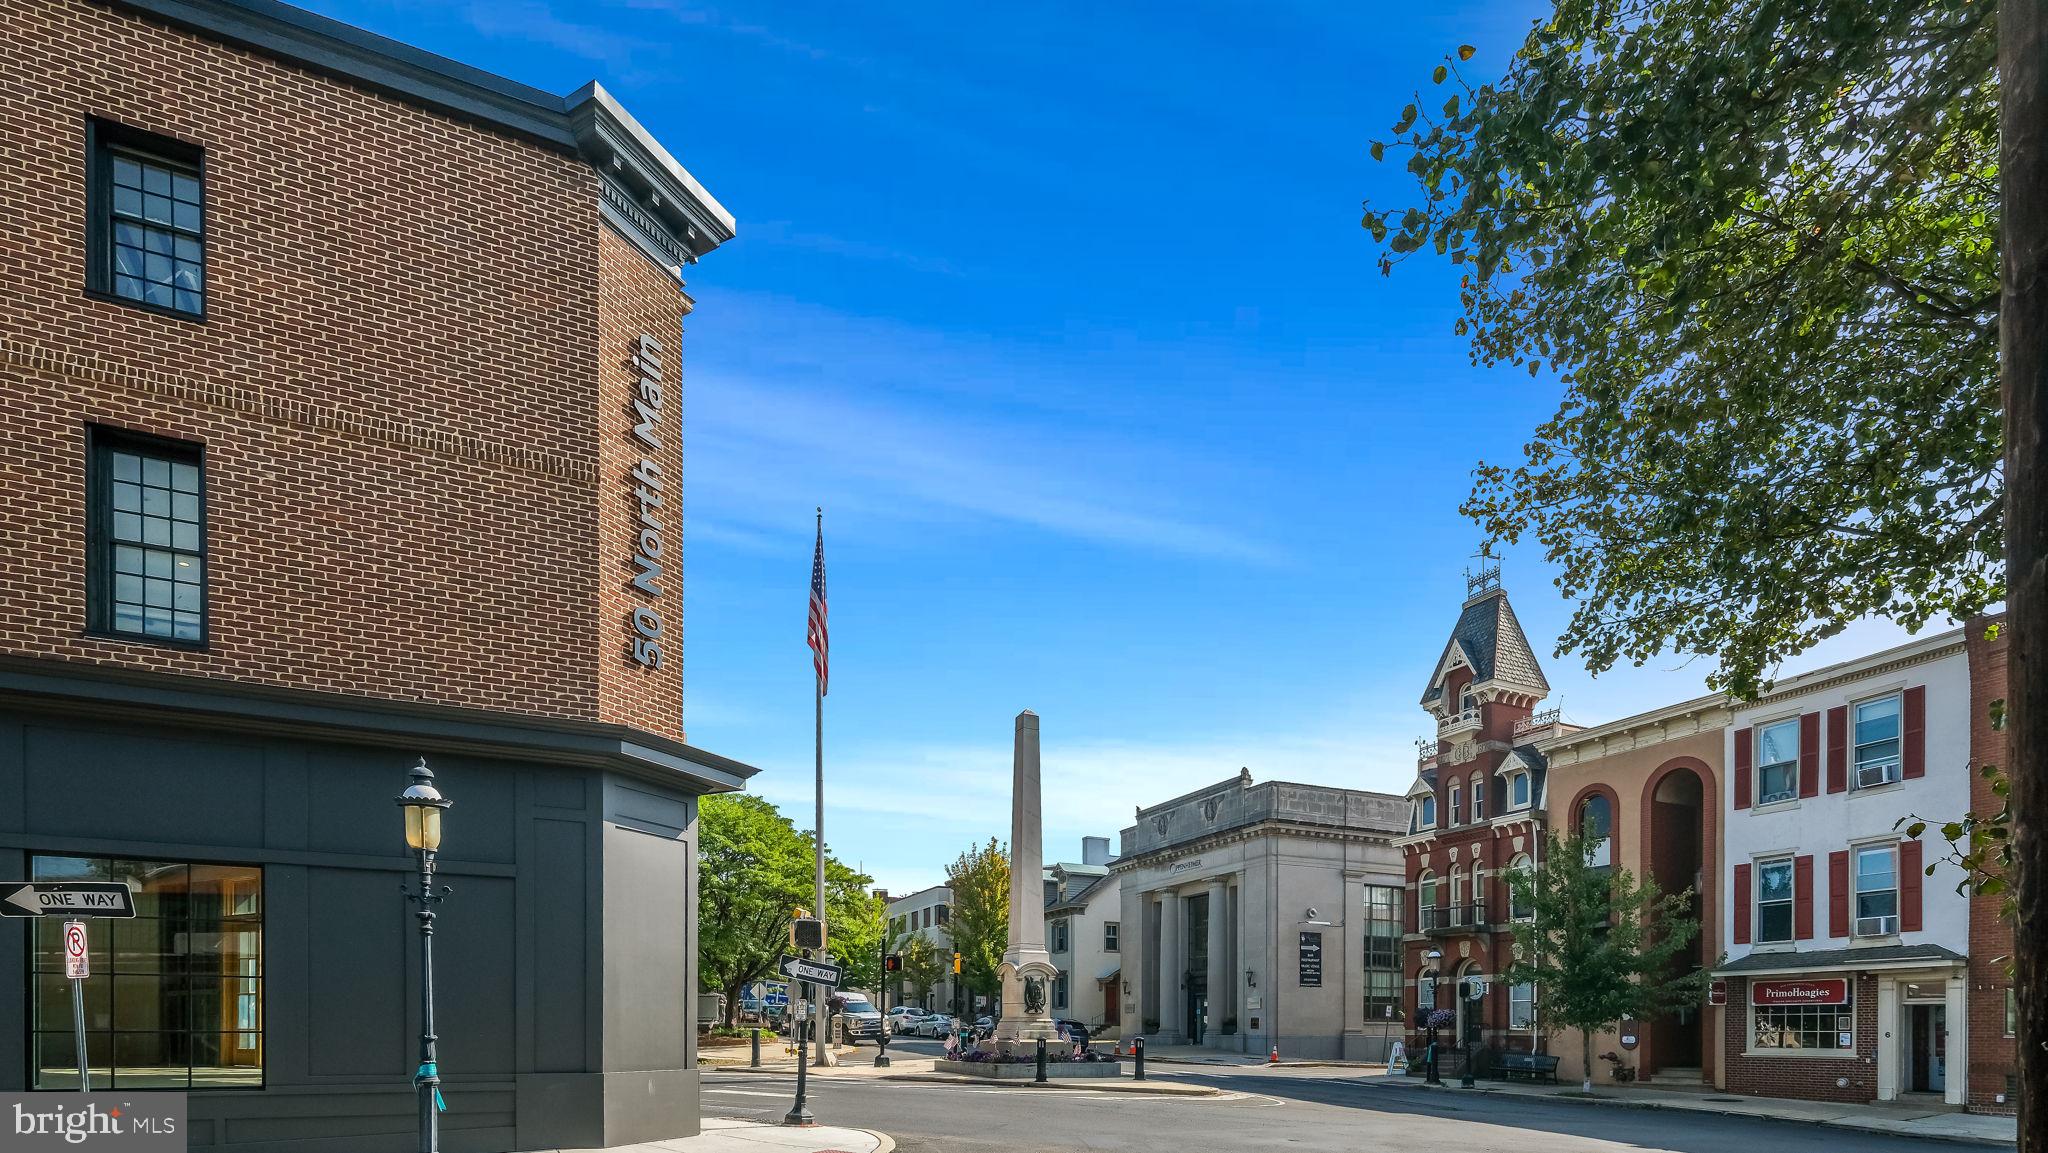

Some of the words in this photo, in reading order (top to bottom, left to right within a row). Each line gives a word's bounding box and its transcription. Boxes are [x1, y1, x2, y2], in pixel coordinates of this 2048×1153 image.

[632, 333, 663, 449] Main
[632, 459, 663, 597] North
[632, 607, 663, 671] 50
[39, 893, 75, 906] ONE
[82, 893, 117, 907] WAY
[798, 965, 814, 976] ONE
[817, 969, 834, 980] WAY
[1766, 988, 1830, 998] PrimoHoagies
